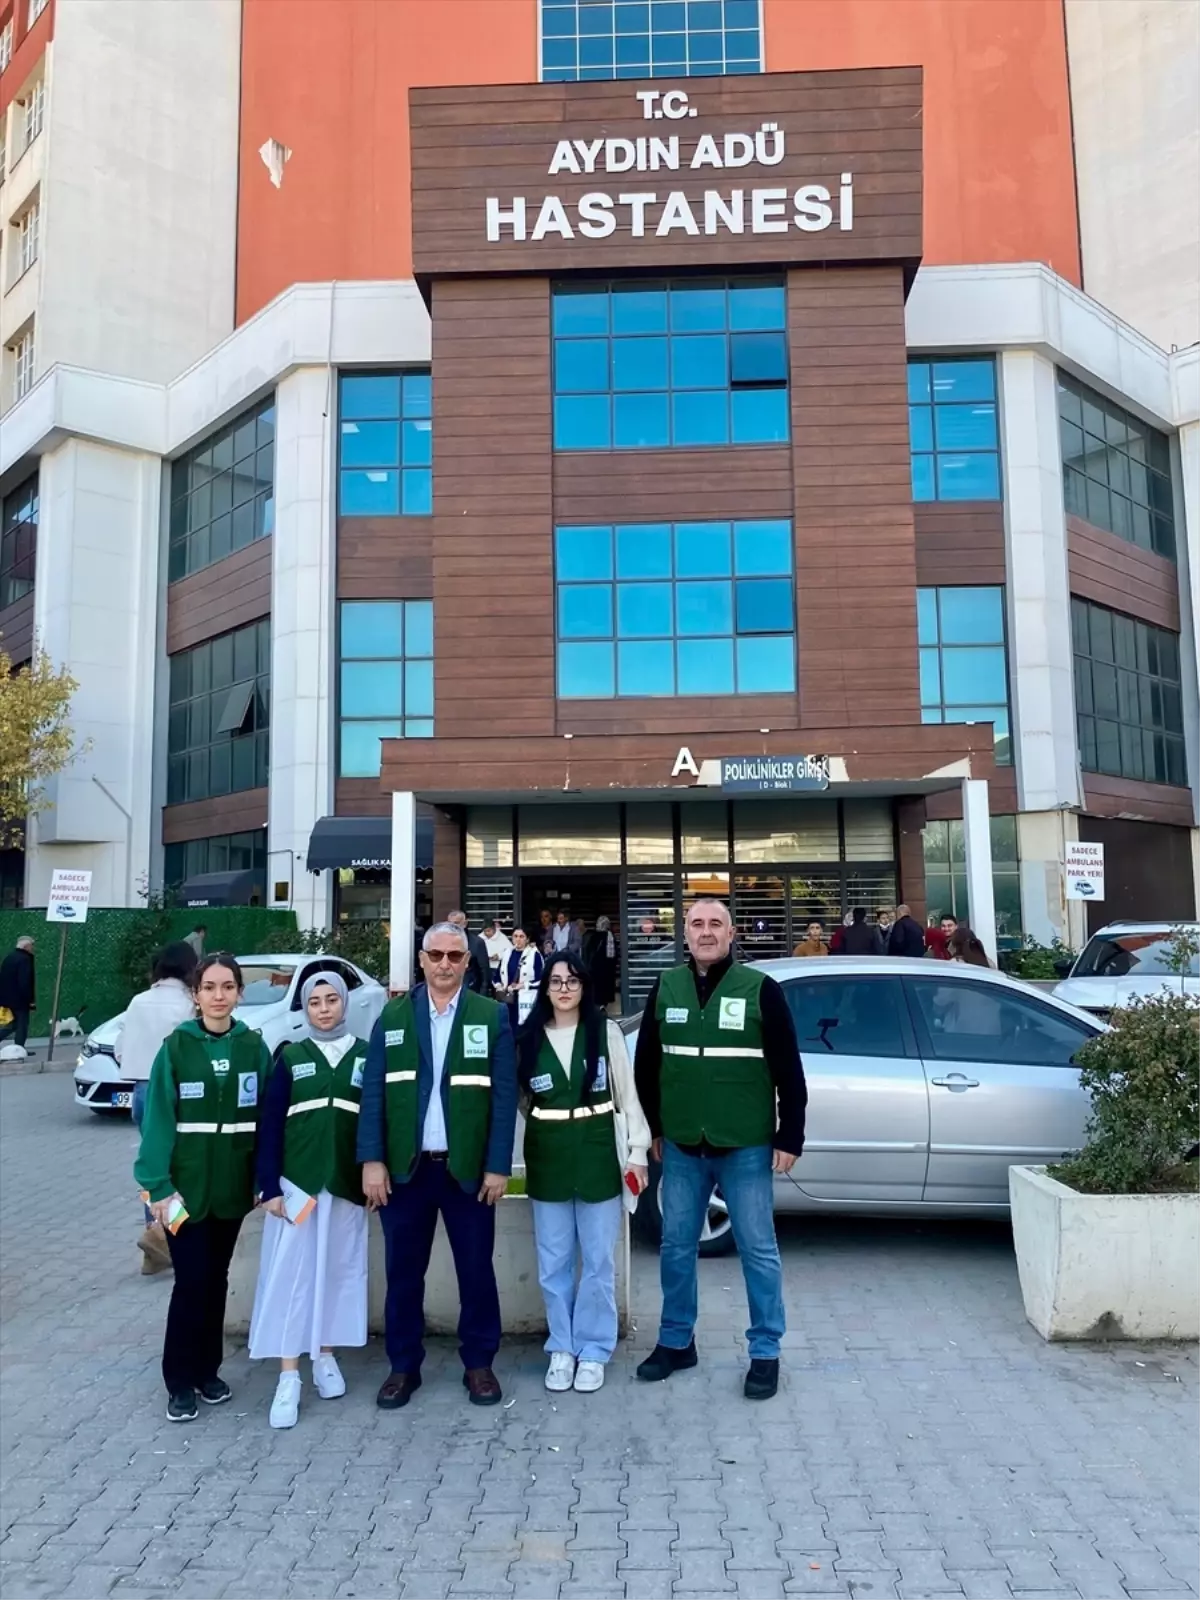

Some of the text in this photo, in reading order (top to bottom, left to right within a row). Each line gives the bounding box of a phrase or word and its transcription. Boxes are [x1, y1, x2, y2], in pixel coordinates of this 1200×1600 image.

[637, 91, 698, 119] T.C.
[548, 123, 785, 174] AYDIN ADÜ
[486, 173, 853, 241] HASTANESİ
[671, 747, 699, 777] A
[725, 758, 794, 780] POLİKLİNİKLER
[351, 858, 379, 866] SAĞLIK
[1071, 847, 1098, 855] SADECE
[1066, 858, 1103, 867] AMBULANS
[1068, 869, 1085, 877] PARK
